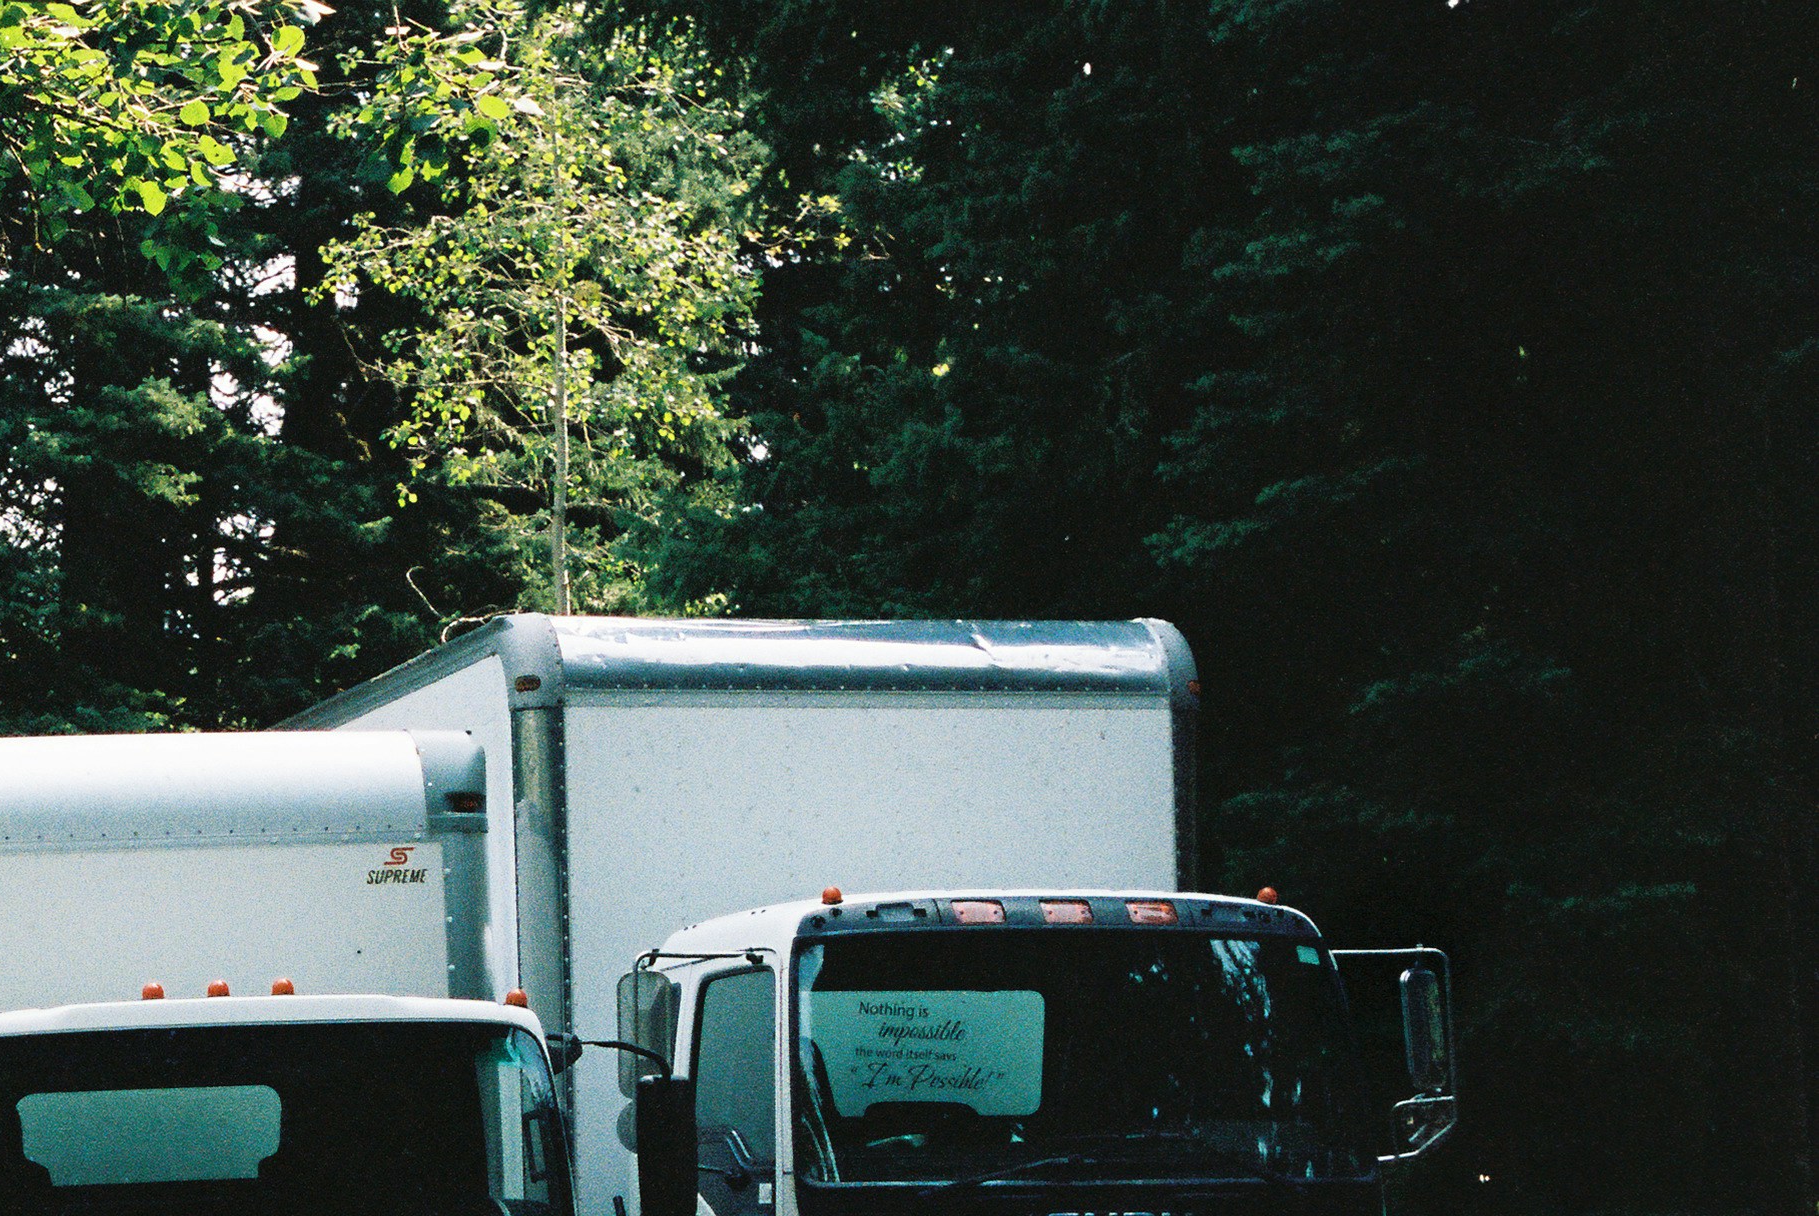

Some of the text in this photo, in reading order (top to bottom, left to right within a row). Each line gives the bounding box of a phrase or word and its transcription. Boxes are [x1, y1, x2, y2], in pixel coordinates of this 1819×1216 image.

[366, 868, 428, 885] SUPREME
[859, 1001, 929, 1021] Nothing is
[878, 1019, 966, 1047] impossible
[855, 1047, 871, 1058] the
[876, 1048, 903, 1060] word
[906, 1049, 932, 1061] itself
